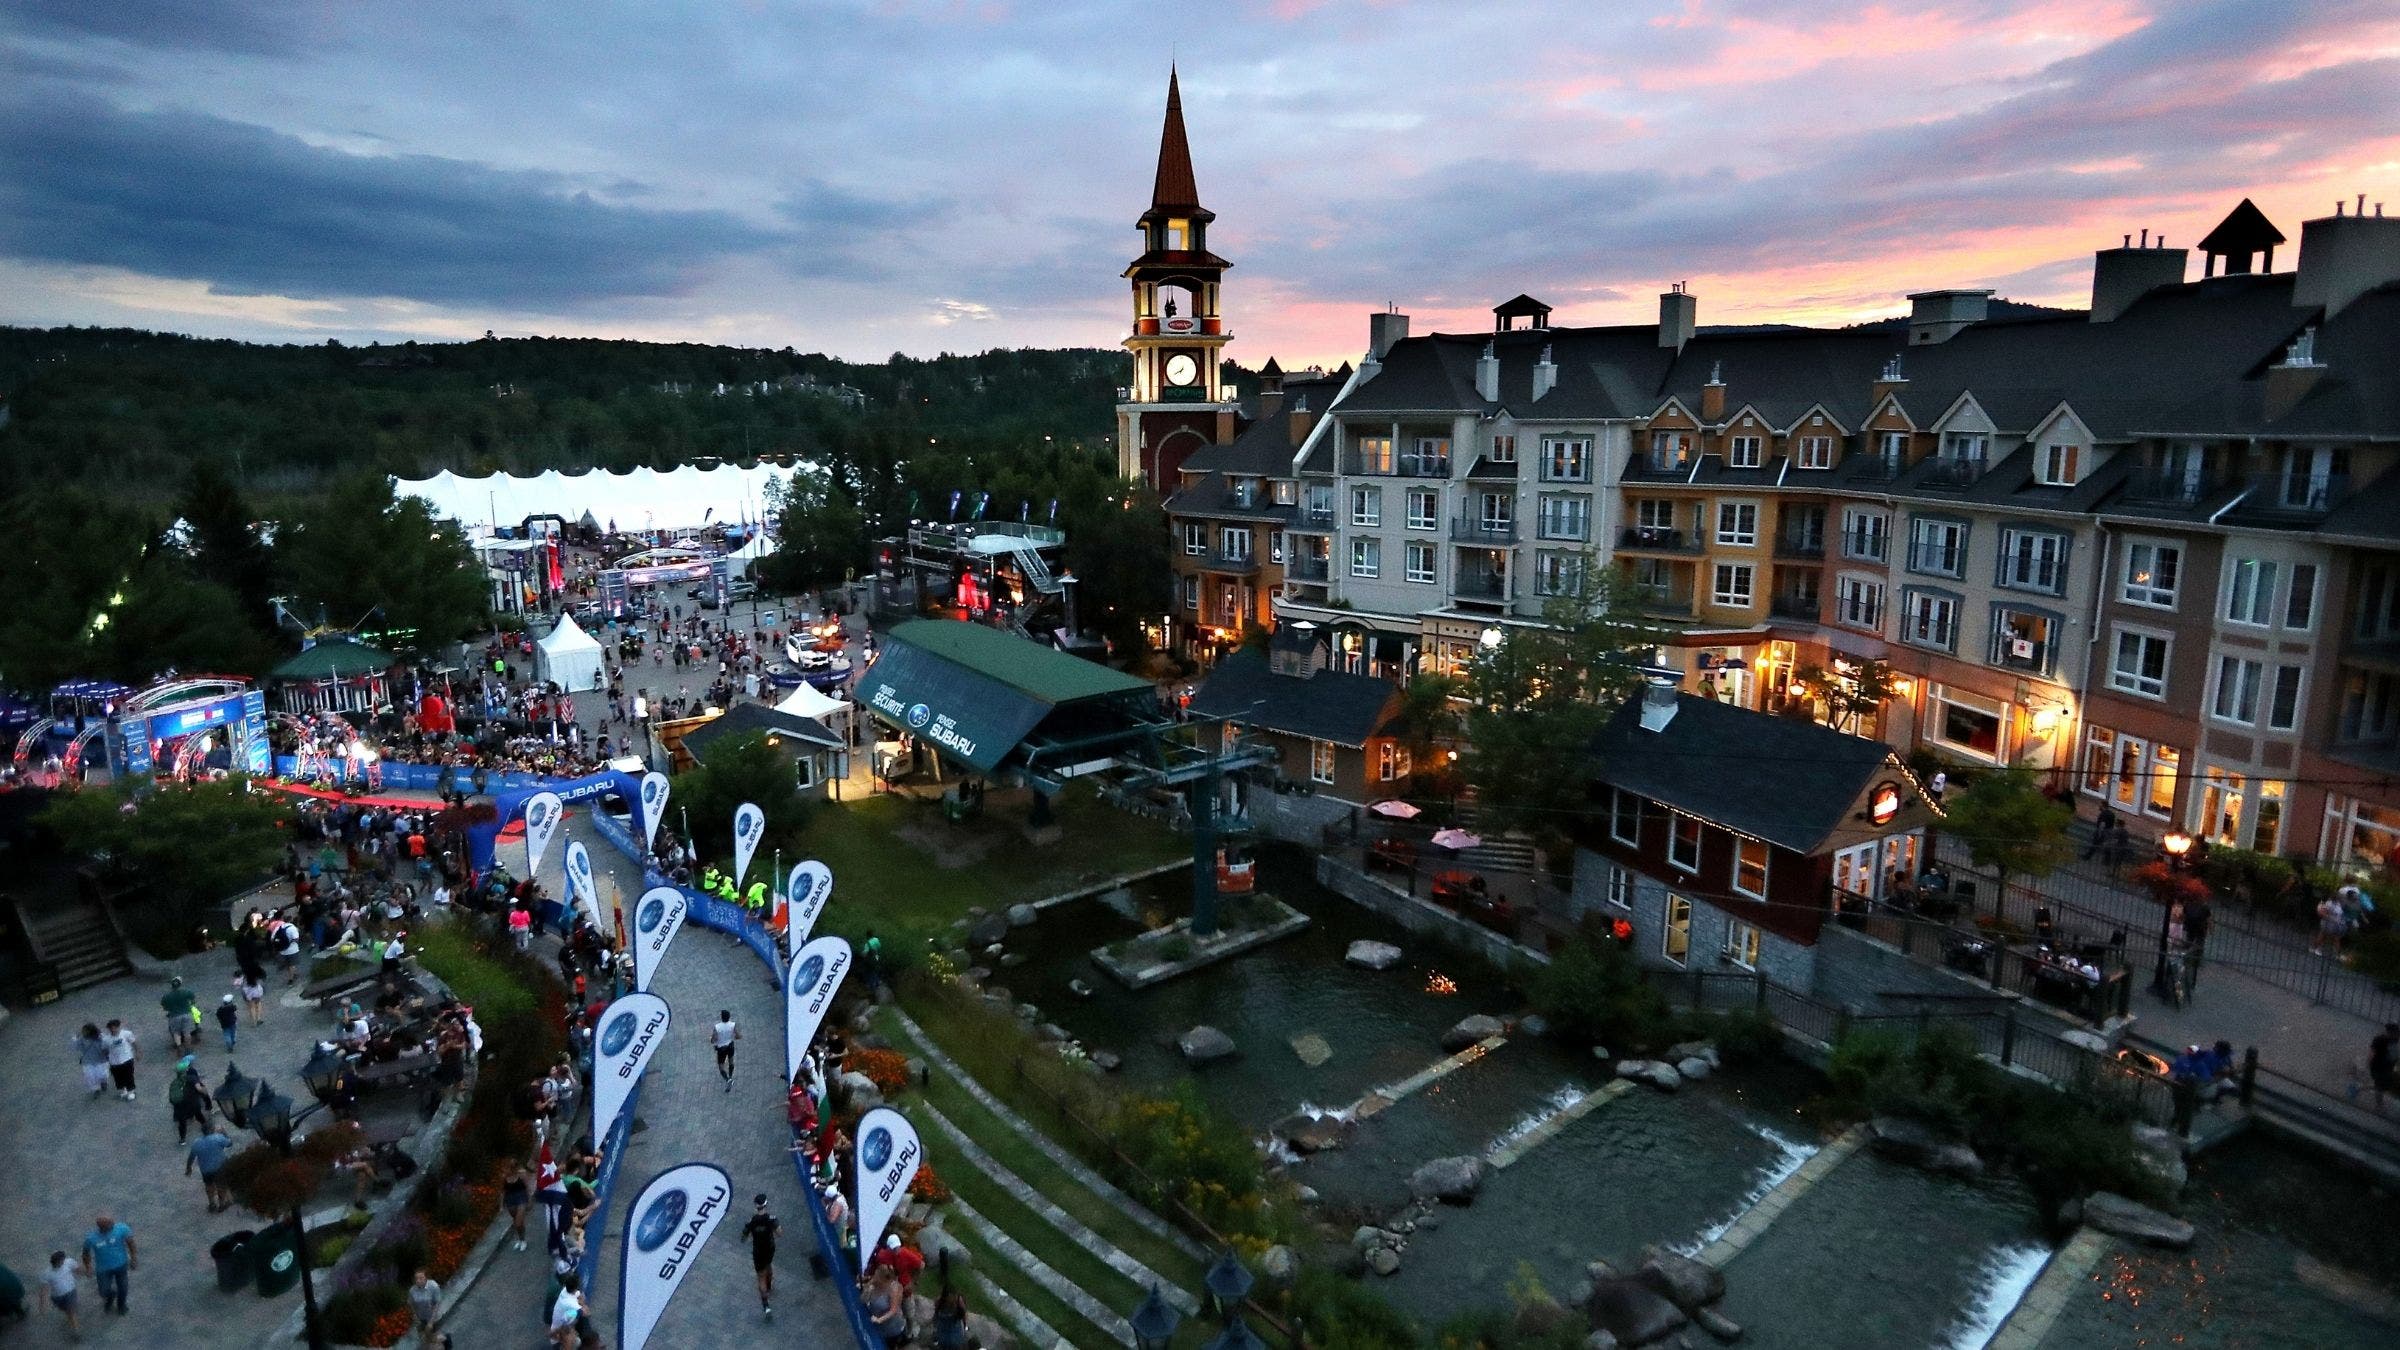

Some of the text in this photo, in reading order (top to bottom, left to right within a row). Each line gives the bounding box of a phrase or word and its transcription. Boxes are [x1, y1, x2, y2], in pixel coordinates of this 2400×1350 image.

[929, 723, 976, 756] SUBARU
[558, 779, 615, 801] SUBARU
[539, 802, 560, 840] SUBARU
[744, 817, 764, 852] SUBARU
[803, 875, 830, 919] SUBARU
[652, 900, 684, 951] SUBARU
[809, 951, 848, 1014] SUBARU
[618, 1010, 666, 1079] SUBARU
[879, 1139, 917, 1203] SUBARU
[658, 1185, 726, 1281] SUBARU
